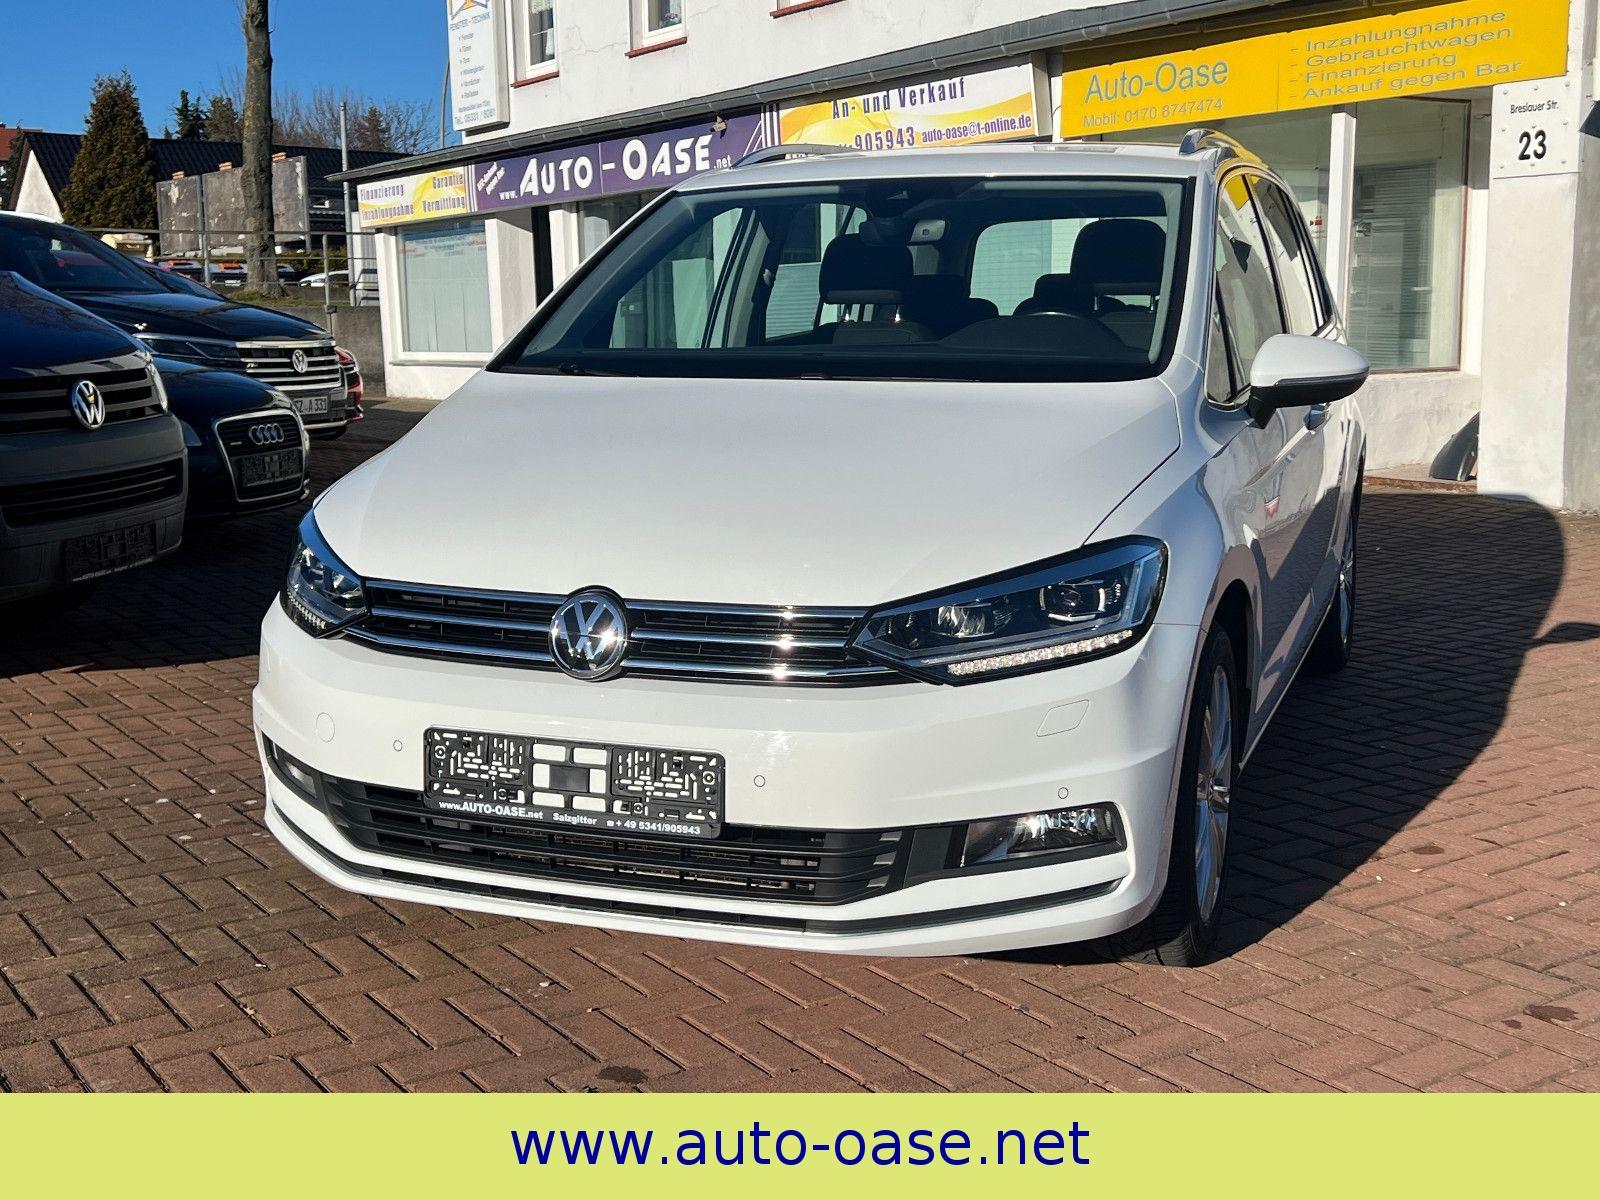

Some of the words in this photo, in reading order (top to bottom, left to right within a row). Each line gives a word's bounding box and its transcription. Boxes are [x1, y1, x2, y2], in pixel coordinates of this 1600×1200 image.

[1306, 11, 1506, 52] Inzahlungnahme
[1306, 27, 1512, 67] Gebrauchtwagen
[1085, 61, 1229, 103] Auto-Oase
[1303, 78, 1382, 100] Ankauf
[1390, 69, 1466, 90] gegen
[1476, 61, 1522, 77] Bar
[1305, 53, 1458, 83] Finanzierung
[863, 91, 891, 114] und
[898, 77, 966, 107] Verkauf
[1083, 111, 1120, 127] Mobil:
[1124, 107, 1158, 123] 0170
[1162, 99, 1223, 118] 8747474
[1510, 102, 1545, 114] Breslauer
[1546, 101, 1559, 111] Str.
[854, 126, 915, 150] 905943
[921, 114, 1032, 142] auto-oase@t-online.de
[1518, 130, 1548, 161] 23
[438, 800, 543, 820] www.AUTO-OASE.net
[552, 812, 597, 826] Salzgitter
[624, 818, 637, 829] 49
[638, 820, 701, 835] 5341/905943
